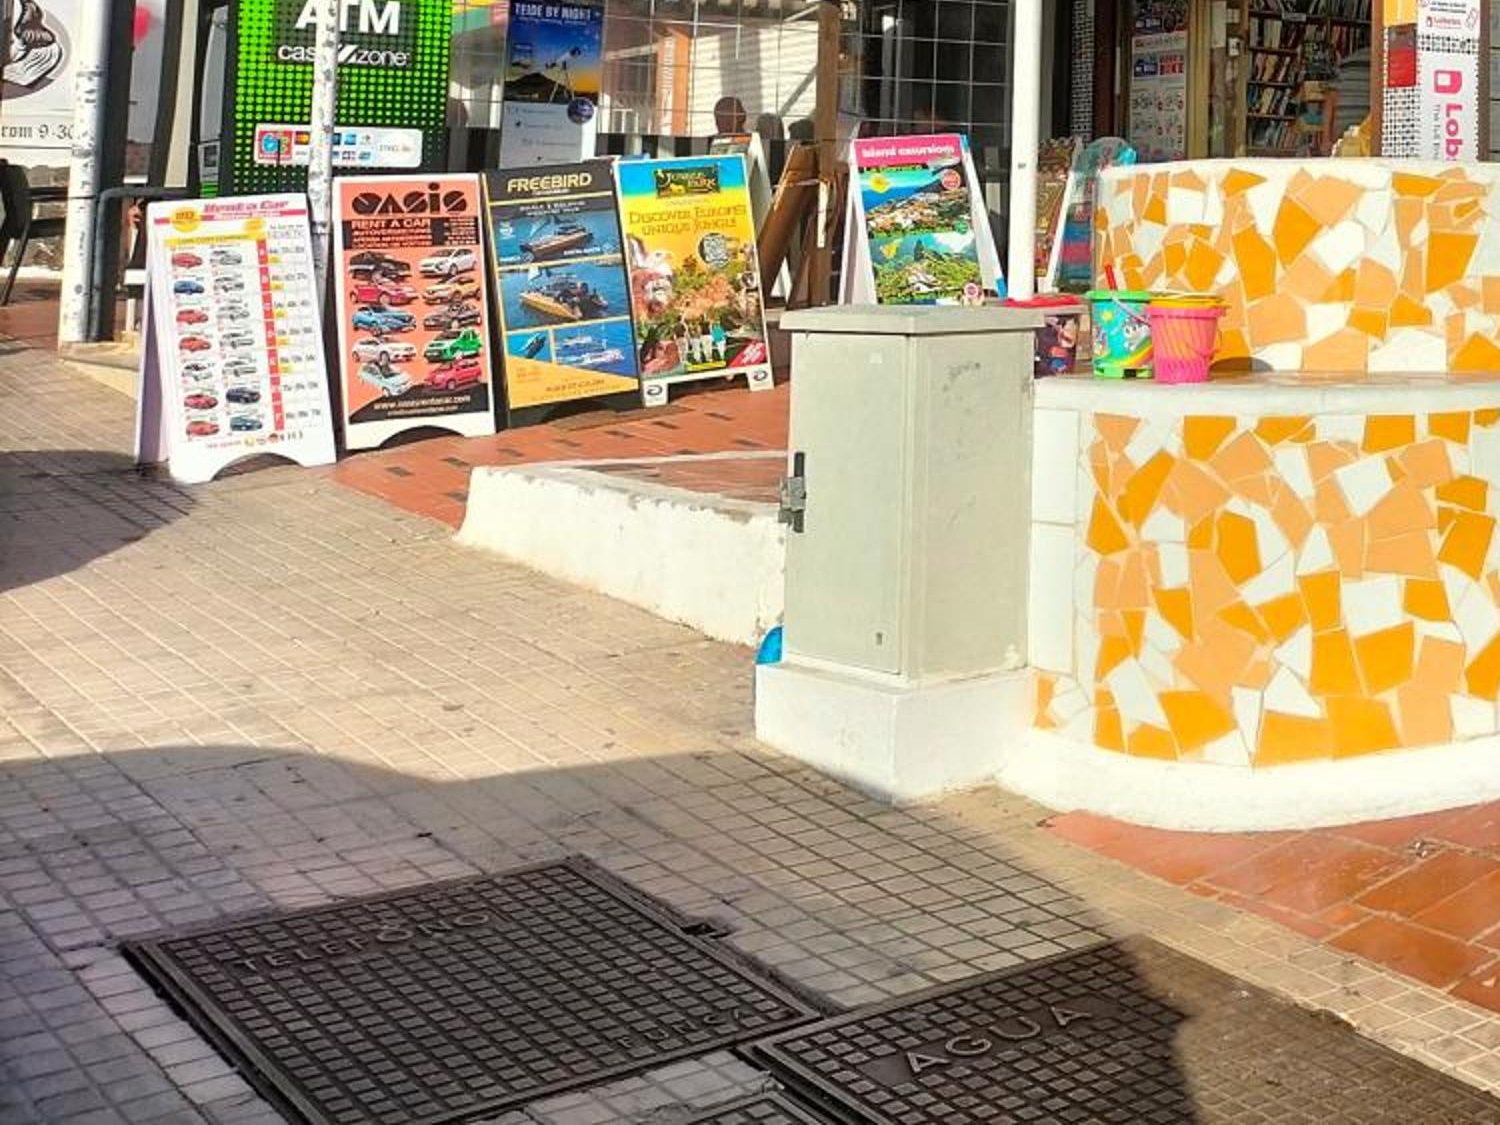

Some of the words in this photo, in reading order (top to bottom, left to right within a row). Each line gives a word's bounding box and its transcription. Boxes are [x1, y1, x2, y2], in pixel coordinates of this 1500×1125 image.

[546, 5, 559, 18] BY
[507, 172, 592, 193] FREEBIRD
[352, 219, 386, 229] RENT
[390, 219, 400, 228] A
[403, 218, 431, 228] CAR
[907, 1006, 1093, 1073] AGUA
